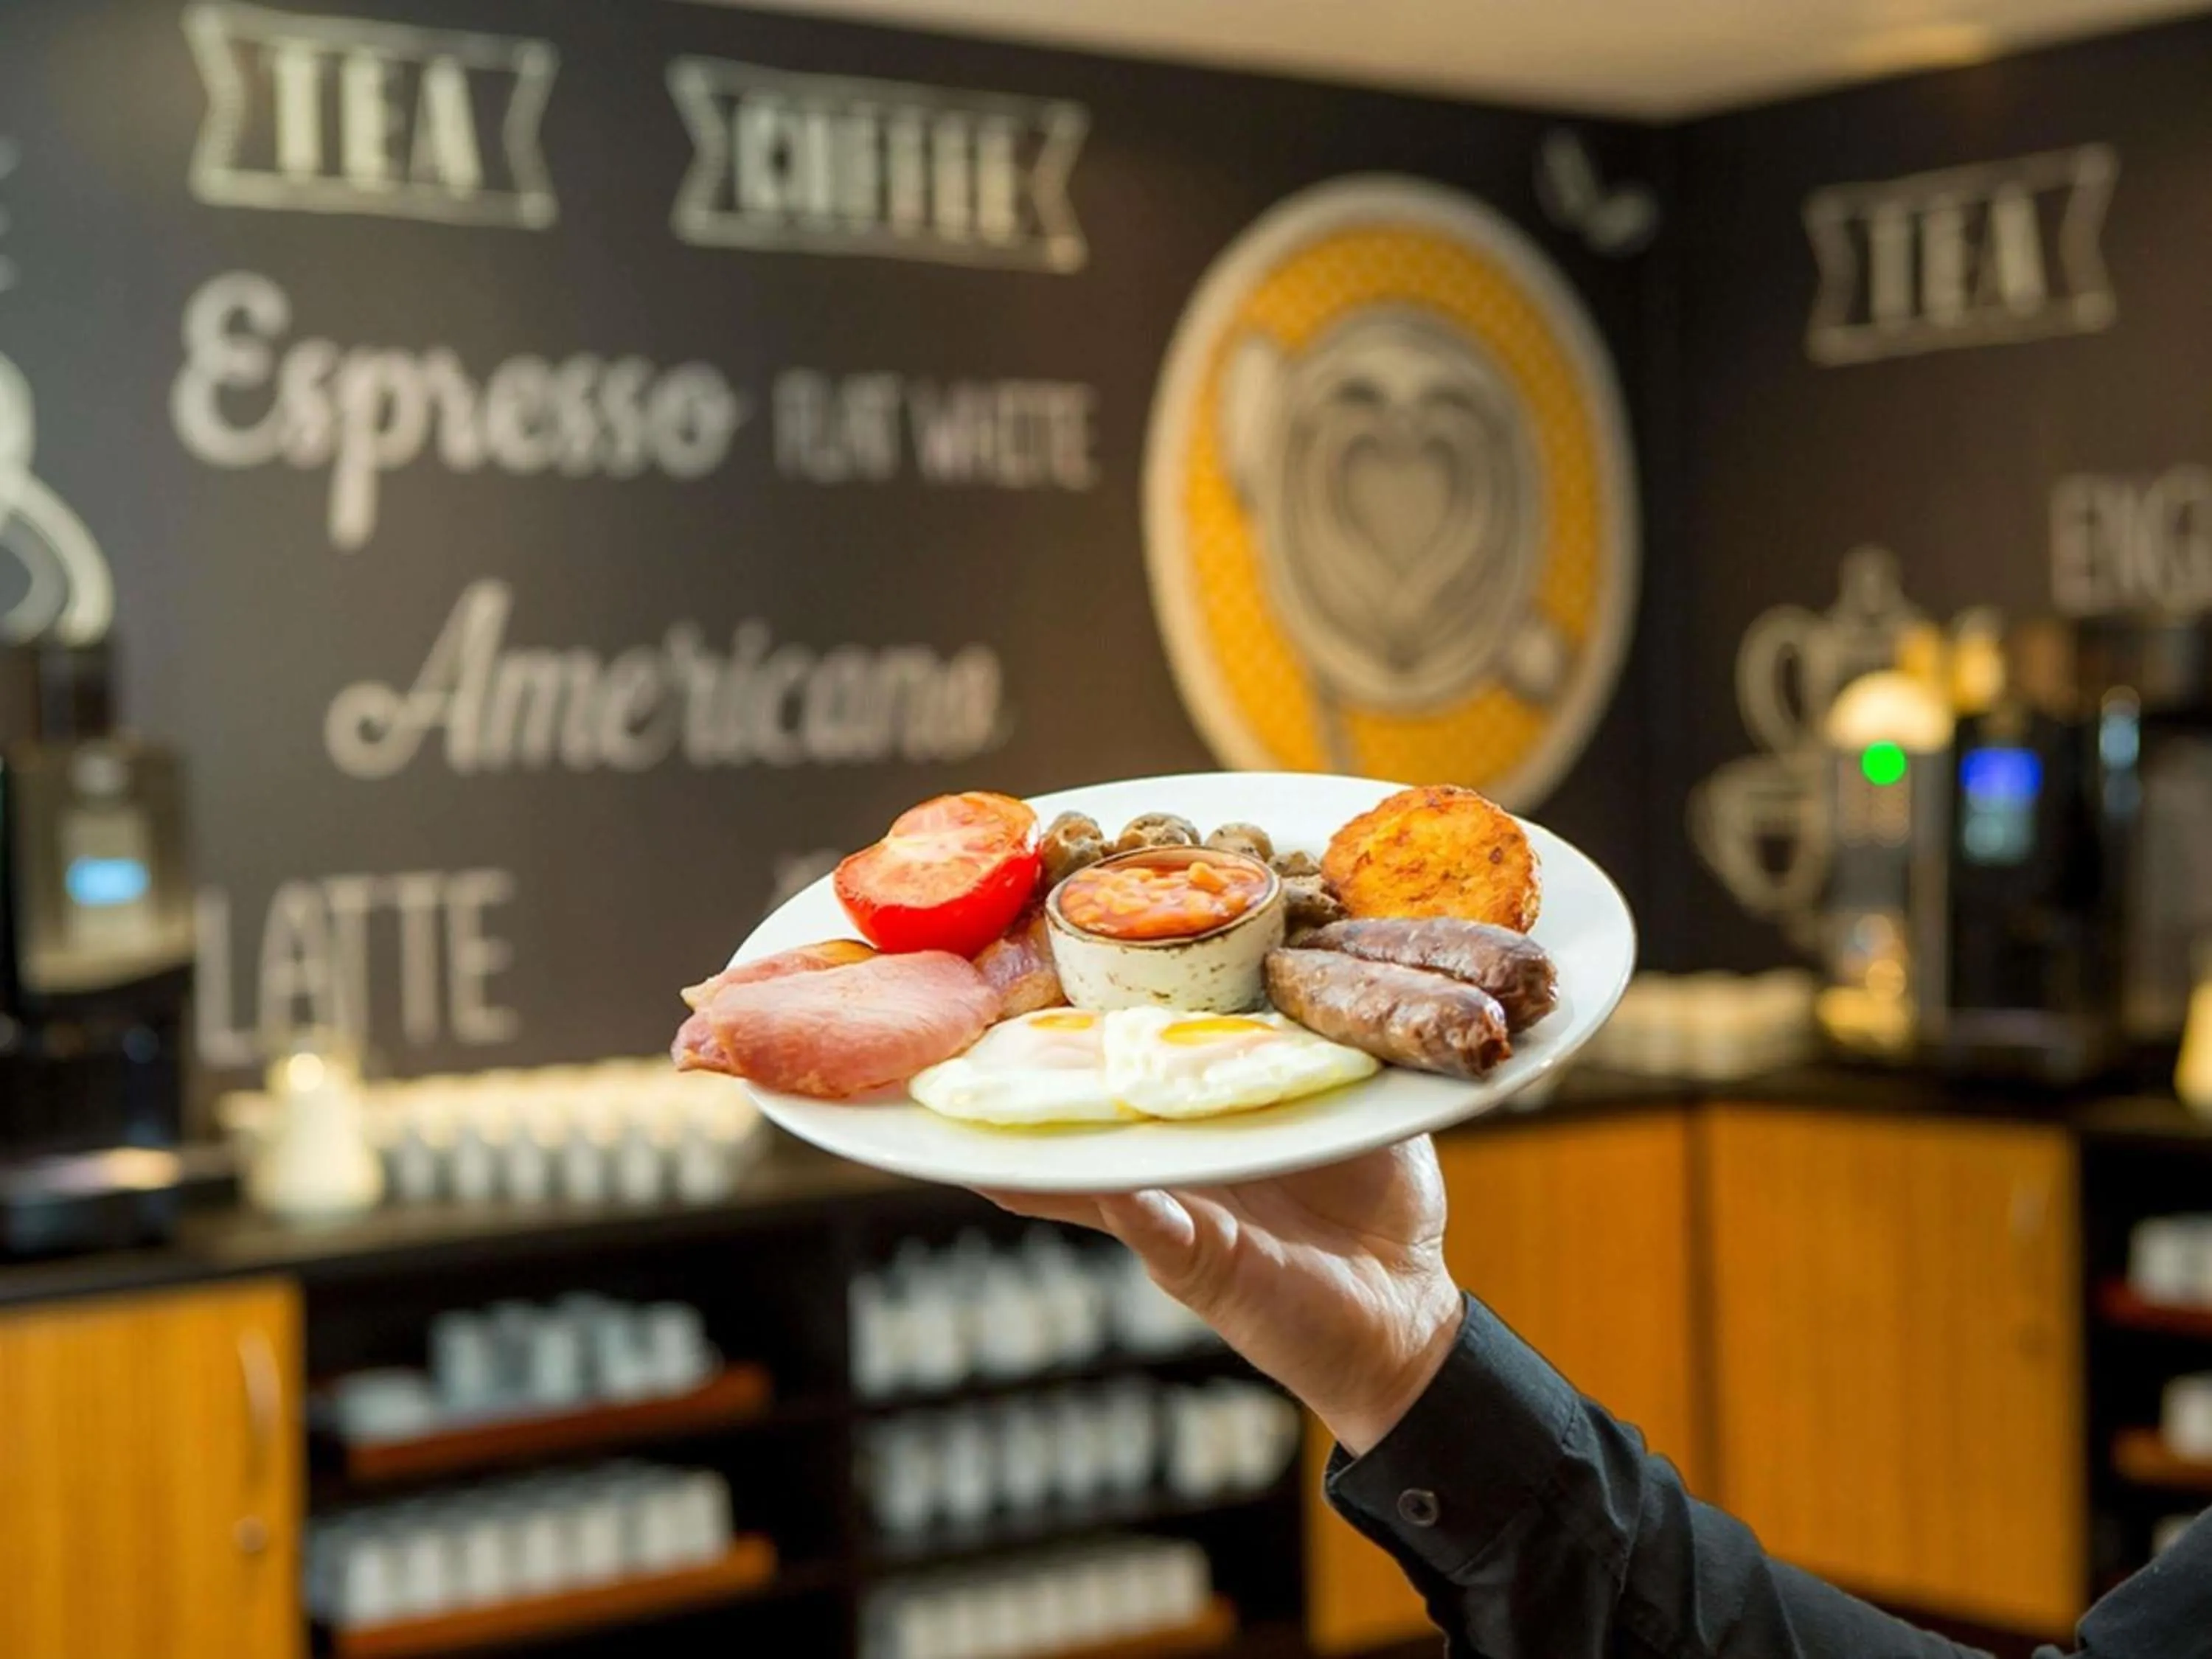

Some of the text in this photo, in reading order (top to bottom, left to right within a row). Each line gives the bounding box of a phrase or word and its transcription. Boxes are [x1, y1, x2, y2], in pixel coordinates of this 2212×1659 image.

[268, 37, 485, 199] TEA
[1867, 184, 2050, 329] TEA
[170, 269, 743, 552] Espresso
[324, 578, 1007, 780] Americano
[193, 869, 518, 1069] LATTE
